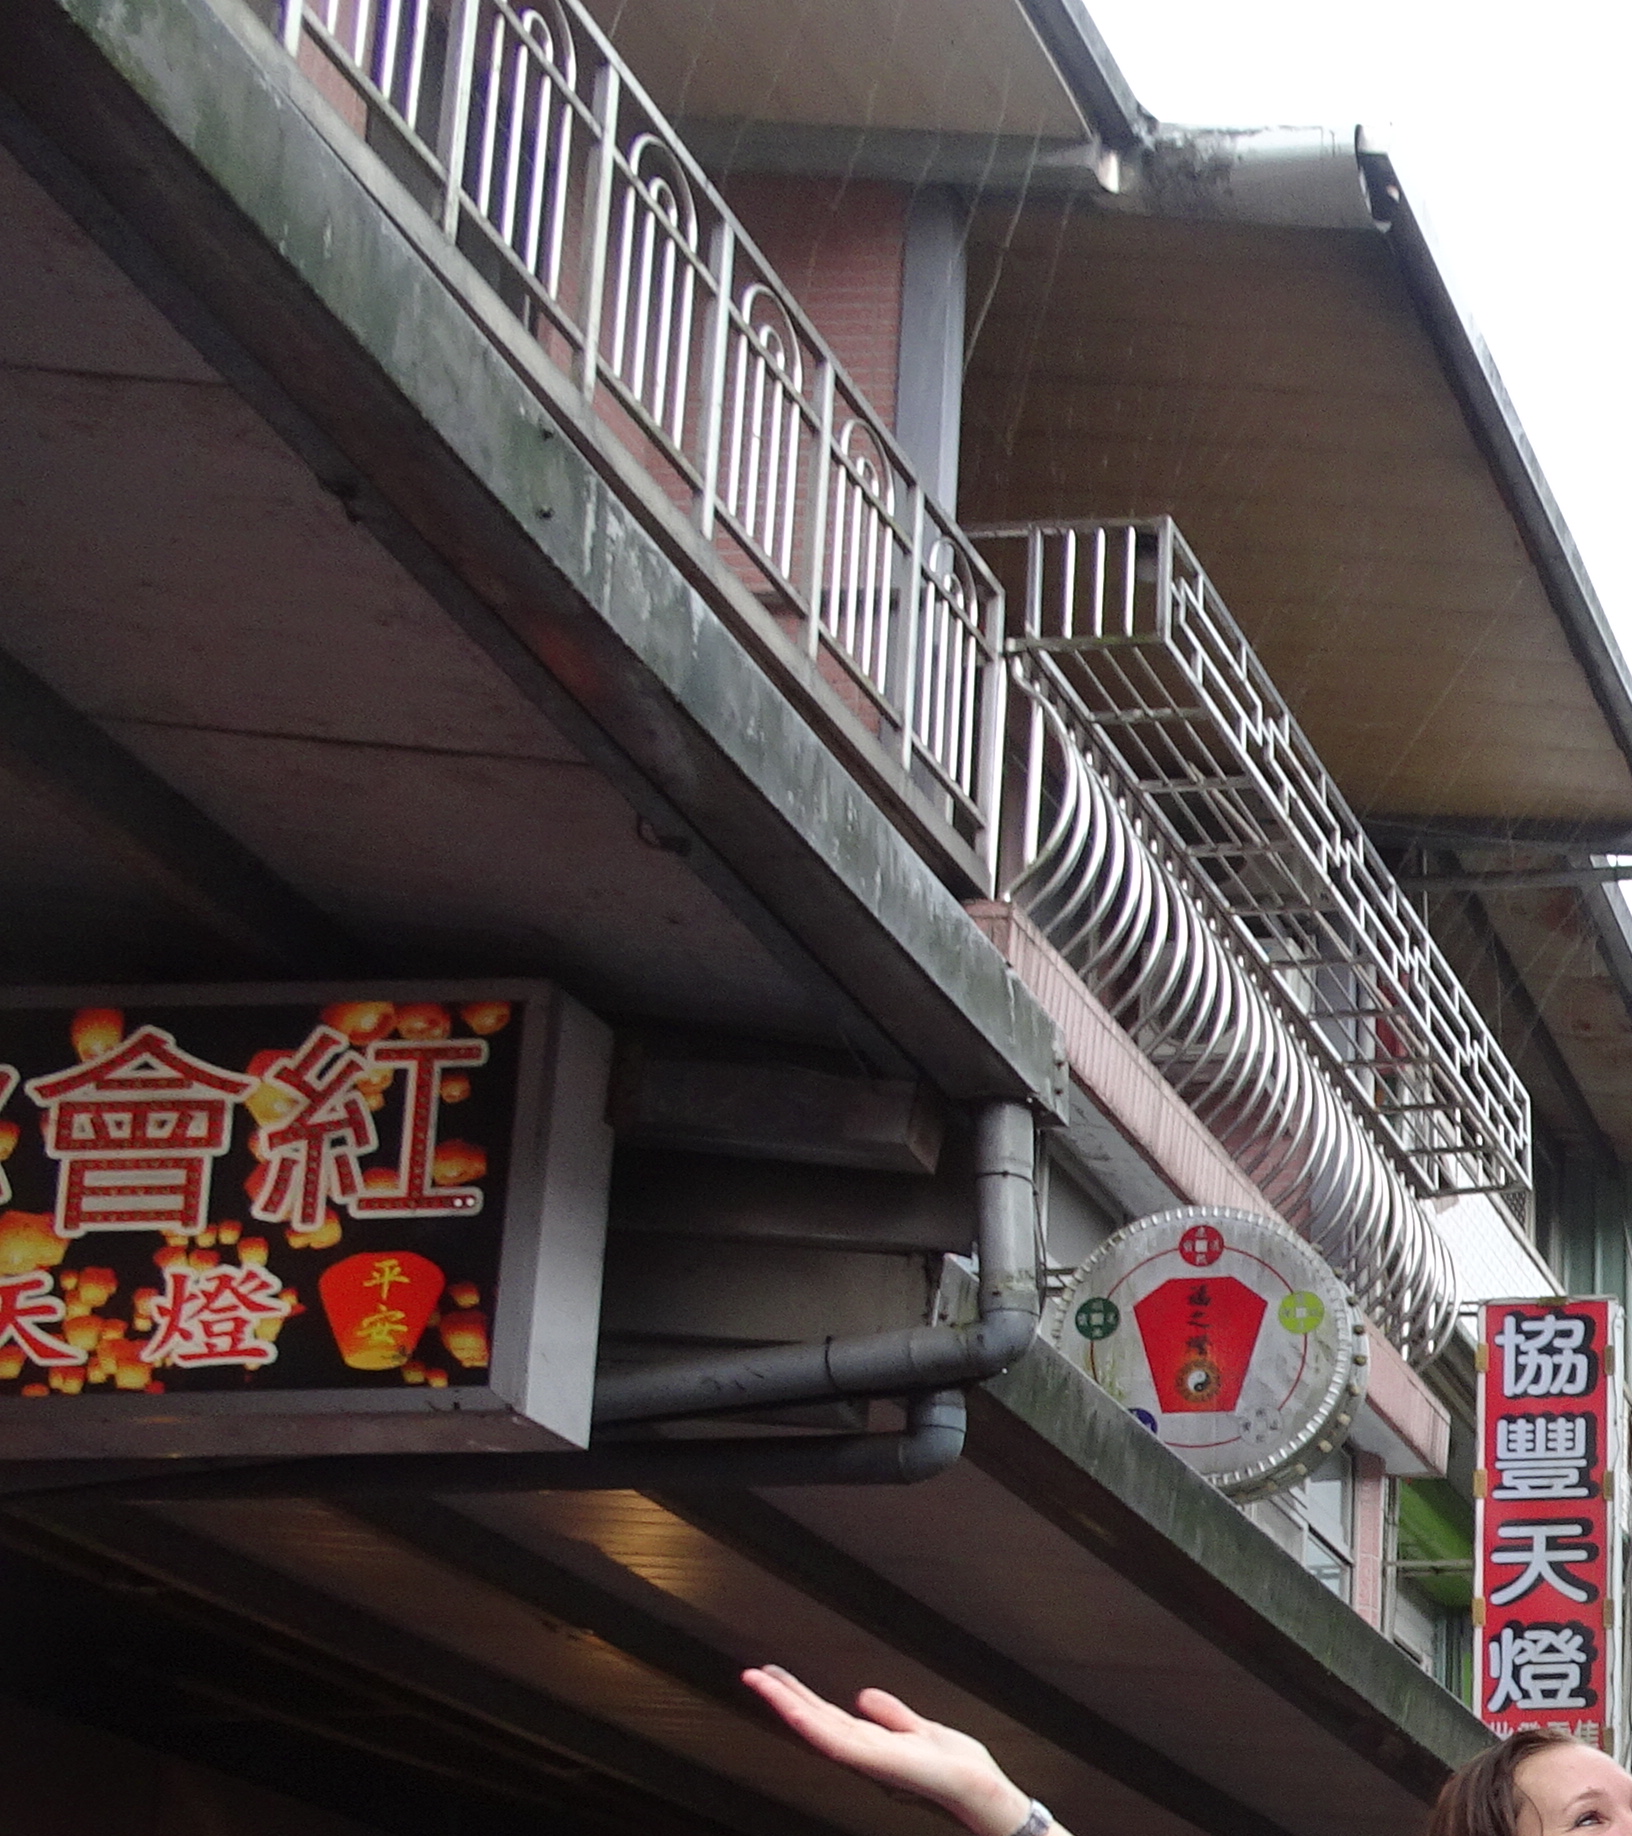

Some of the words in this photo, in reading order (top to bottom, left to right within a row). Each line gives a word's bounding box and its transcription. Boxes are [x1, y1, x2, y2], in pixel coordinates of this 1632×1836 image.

[0, 1024, 489, 1236] 會紅
[357, 1257, 411, 1347] 平安
[1487, 1313, 1592, 1714] 協豐天燈
